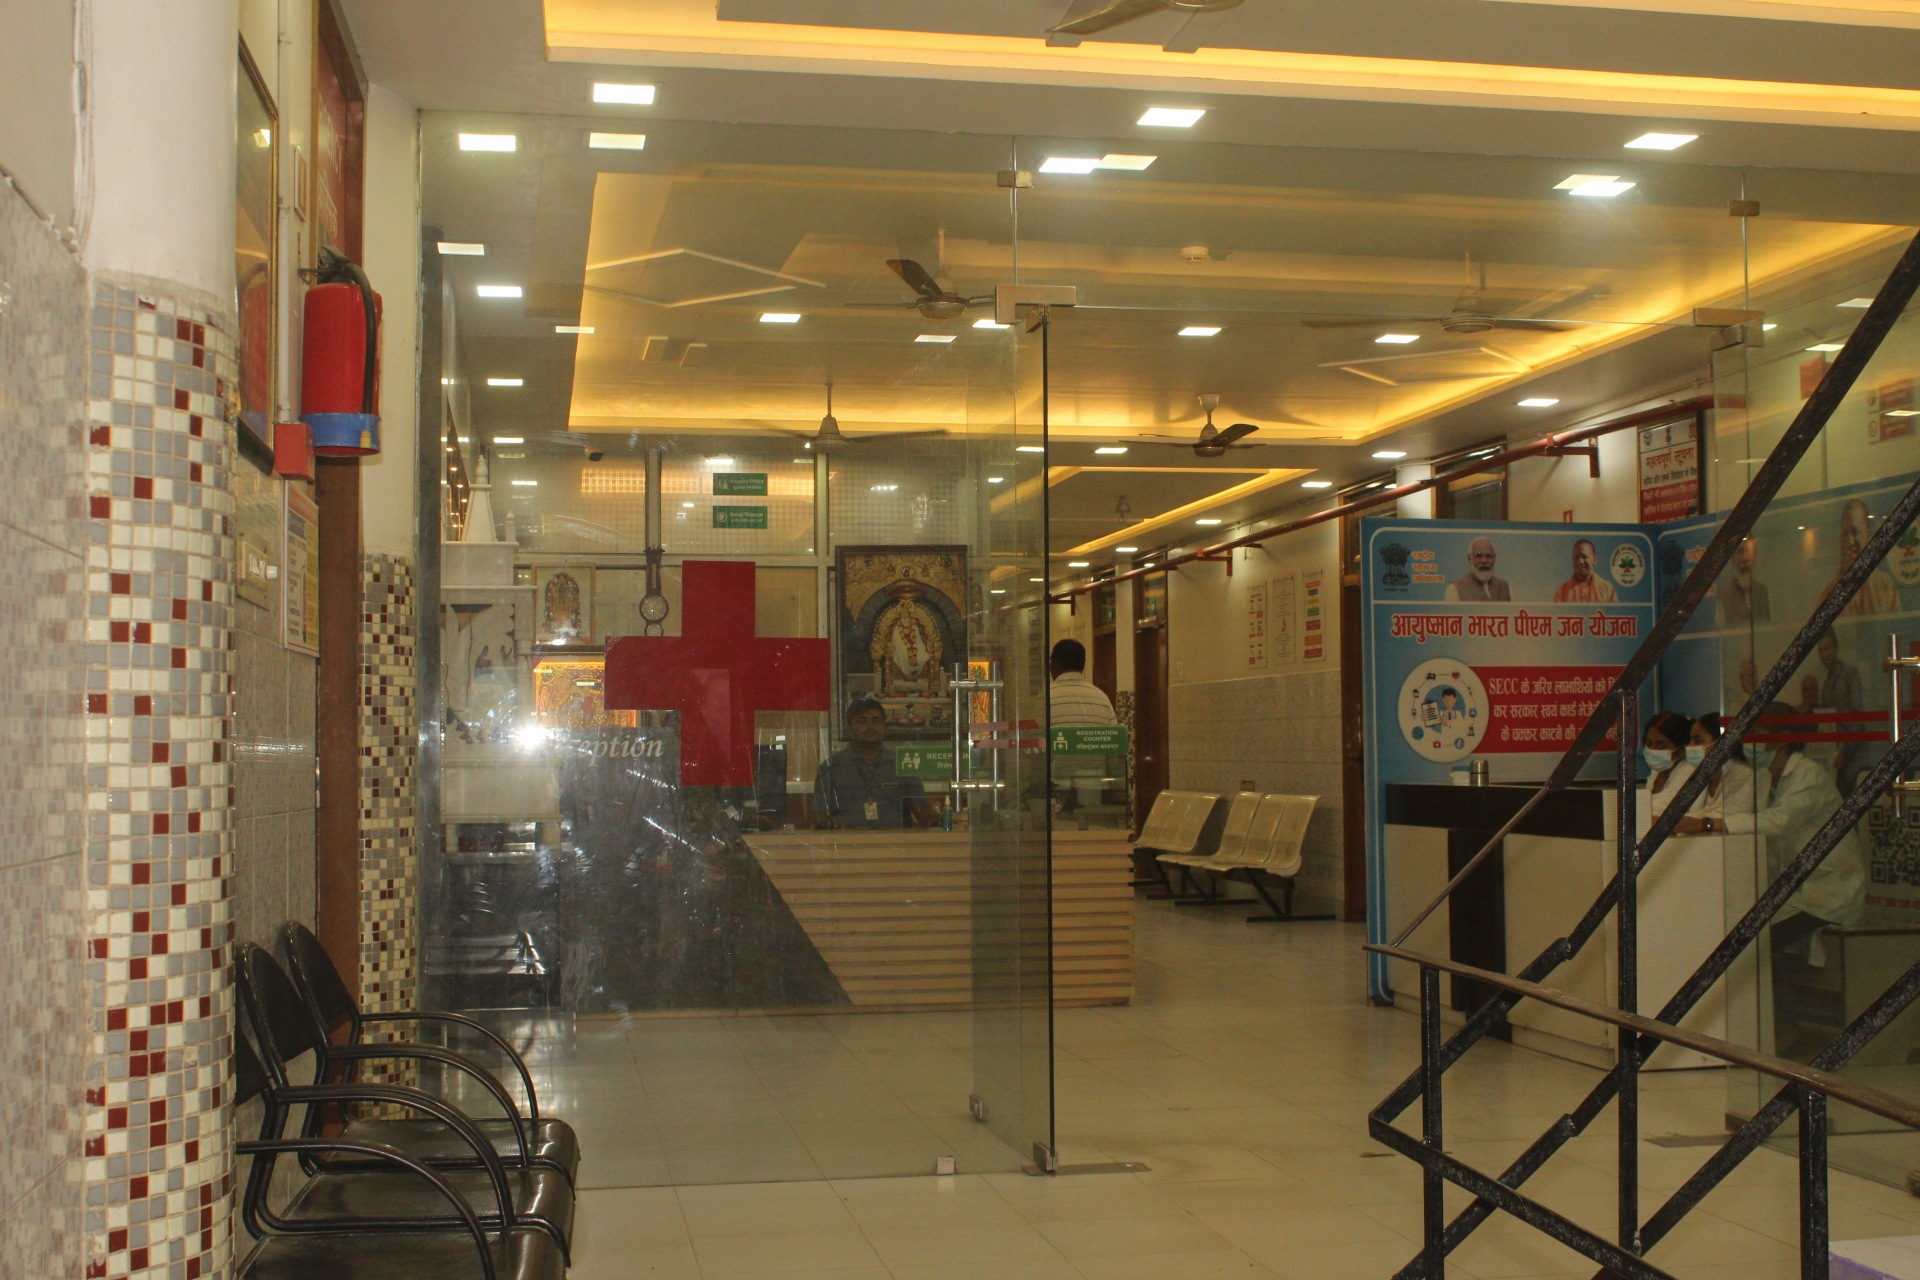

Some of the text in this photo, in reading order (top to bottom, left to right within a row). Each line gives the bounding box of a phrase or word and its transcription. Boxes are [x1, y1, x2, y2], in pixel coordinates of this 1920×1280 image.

[1391, 609, 1638, 643] आयुष्मान भारत पीएम जन योजना
[1489, 677, 1519, 694] SECC
[1521, 678, 1530, 694] के
[1532, 676, 1553, 695] जरिए
[1595, 677, 1606, 694] को
[1493, 704, 1508, 718] कर
[1510, 704, 1539, 719] सरकार
[1541, 701, 1558, 718] स्वयं
[1559, 701, 1577, 717] कार्ड
[1501, 725, 1510, 741] के
[1512, 727, 1538, 741] चक्कर
[1540, 724, 1563, 741] काटने
[1565, 724, 1576, 741] की
[926, 752, 969, 760] RECEPON
